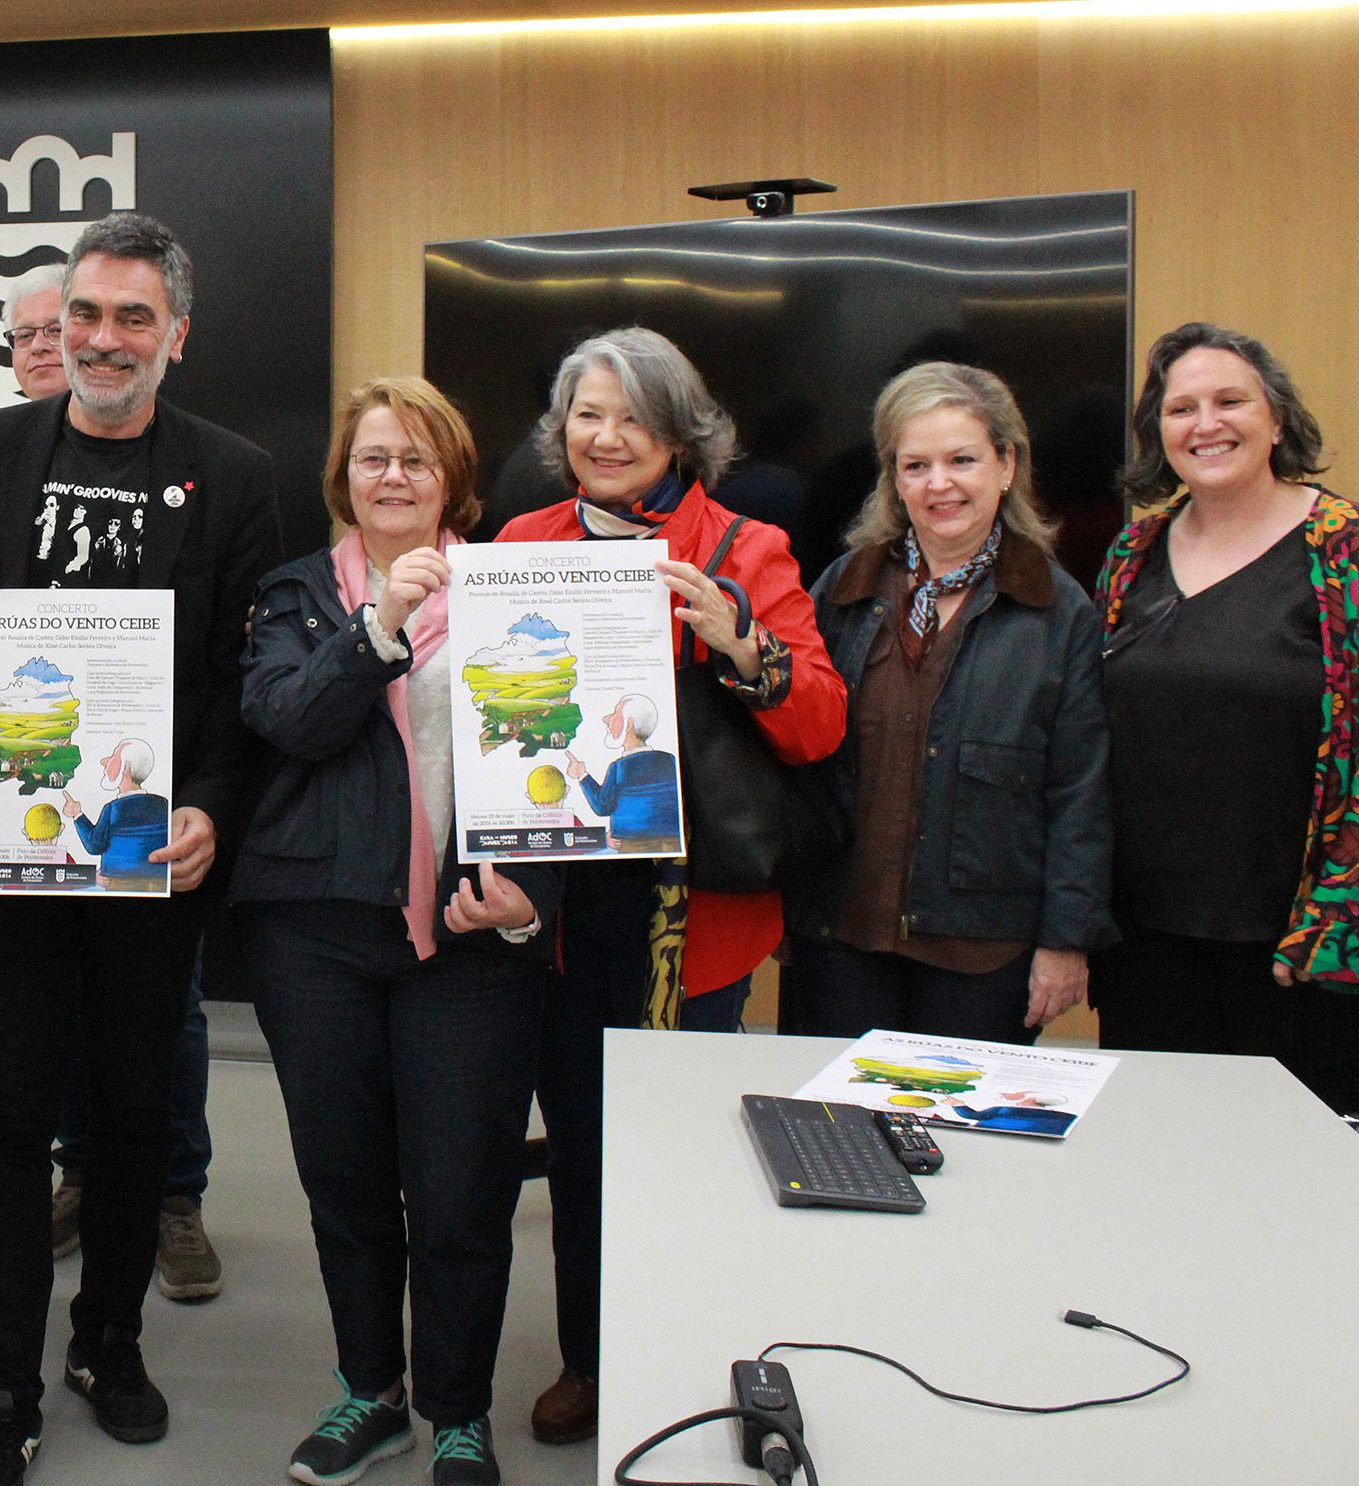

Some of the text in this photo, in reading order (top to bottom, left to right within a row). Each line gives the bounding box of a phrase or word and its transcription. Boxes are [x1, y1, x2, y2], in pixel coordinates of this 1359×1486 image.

[73, 486, 137, 503] GROOVIES
[528, 556, 591, 568] CONCERTO
[464, 569, 656, 586] AS RÚAS DO VENTO CEIBE
[36, 603, 97, 614] CONCERTO
[40, 618, 62, 629] DO
[65, 618, 117, 630] VENTO
[119, 618, 160, 630] CEIBE
